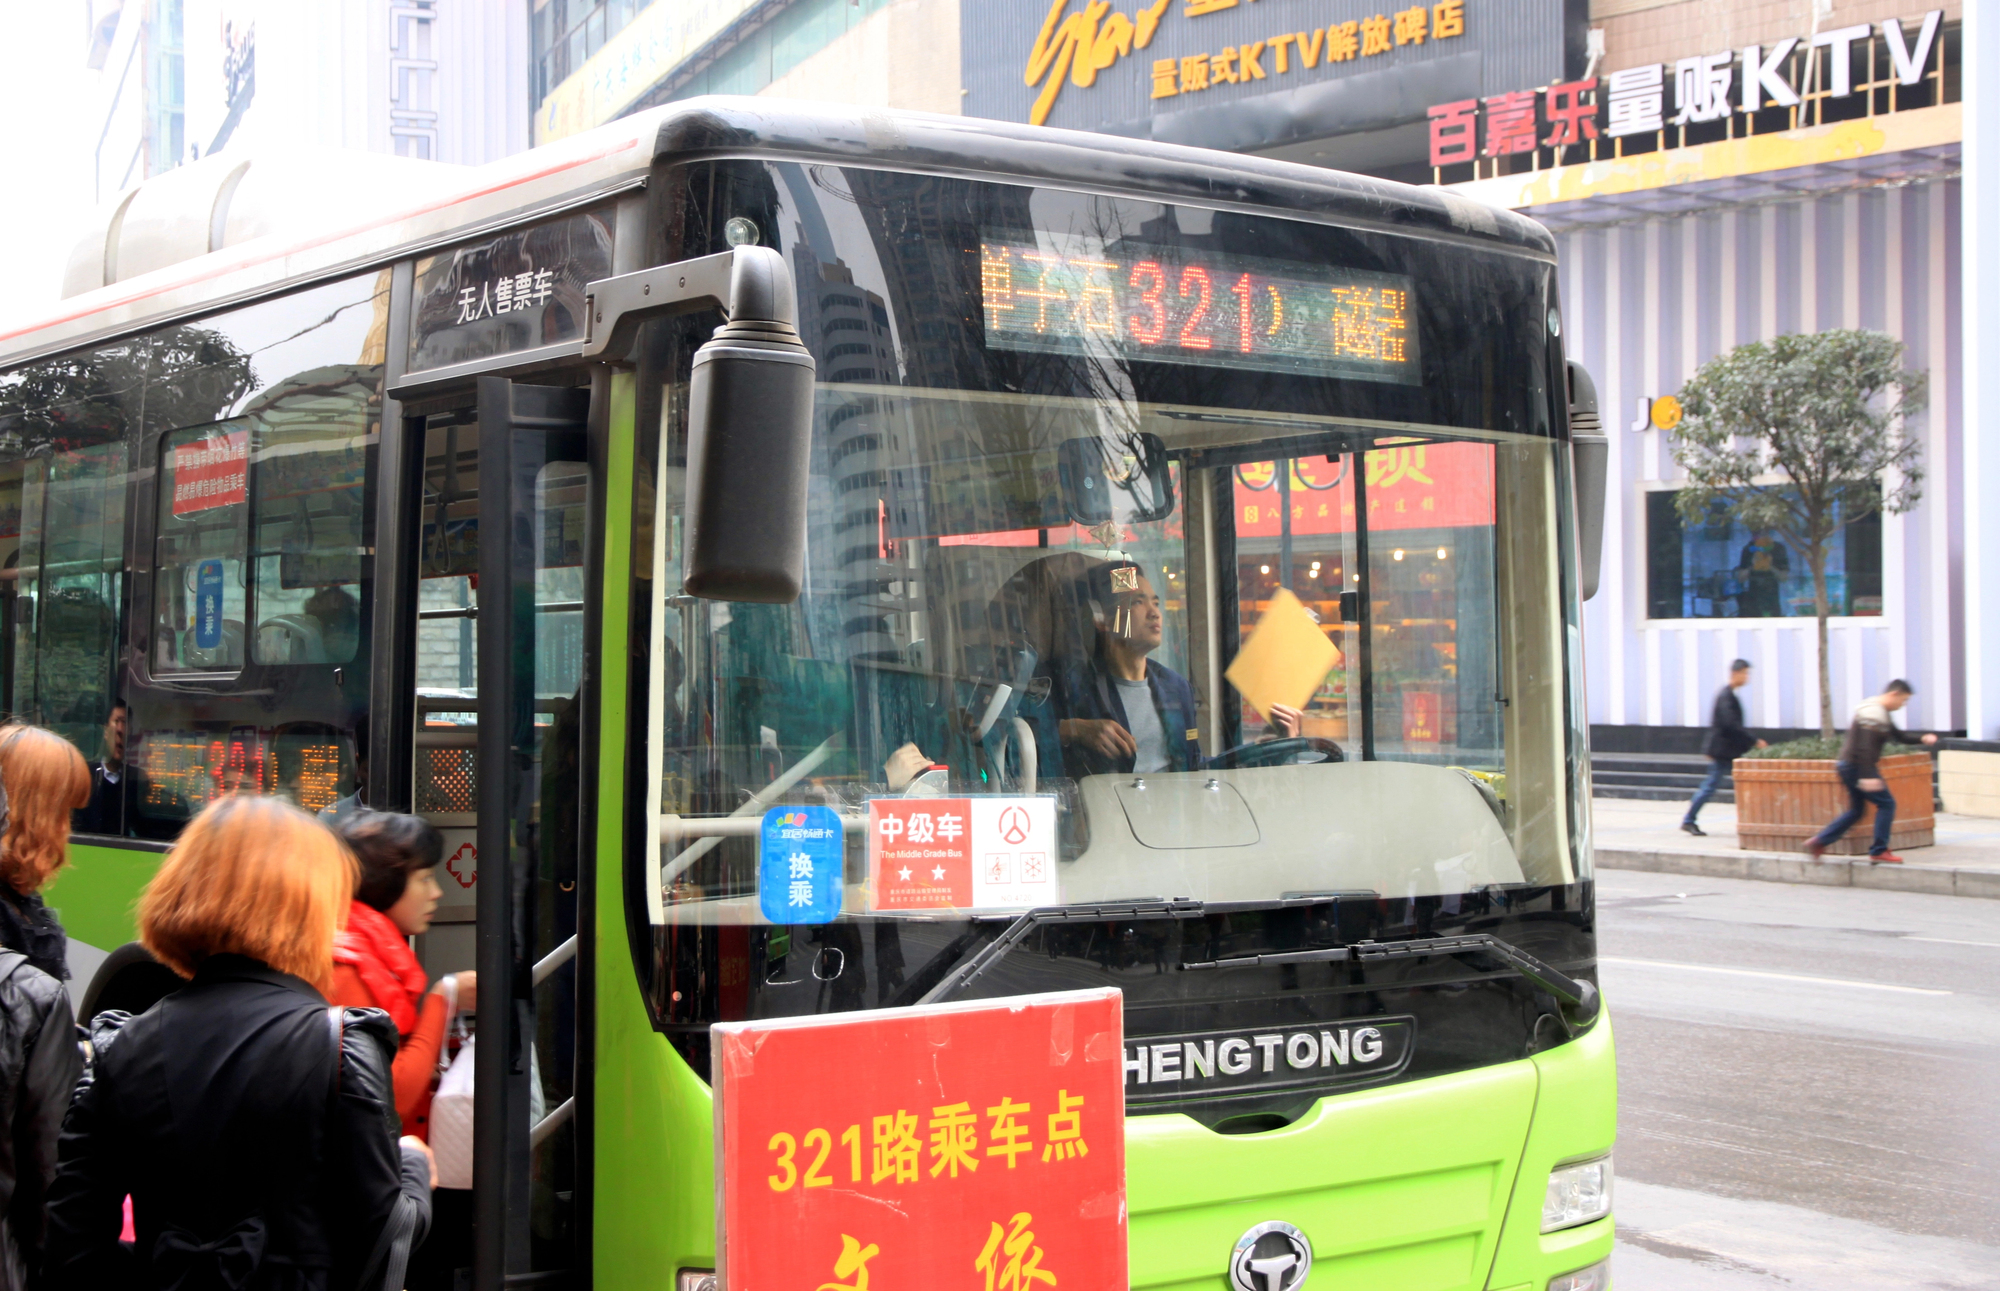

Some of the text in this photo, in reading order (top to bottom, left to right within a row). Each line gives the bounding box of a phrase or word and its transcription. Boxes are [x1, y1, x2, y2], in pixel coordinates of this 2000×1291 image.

[1151, 1, 1465, 99] 量贩式KTV解放碑店
[457, 267, 553, 325] 无人售票车
[175, 472, 245, 502] 易燃易爆危险物品乘车
[879, 812, 963, 843] 中级车
[881, 848, 963, 859] The Middle Grade Bus
[788, 852, 814, 907] 换乘
[768, 1089, 1089, 1192] 321路乘车点
